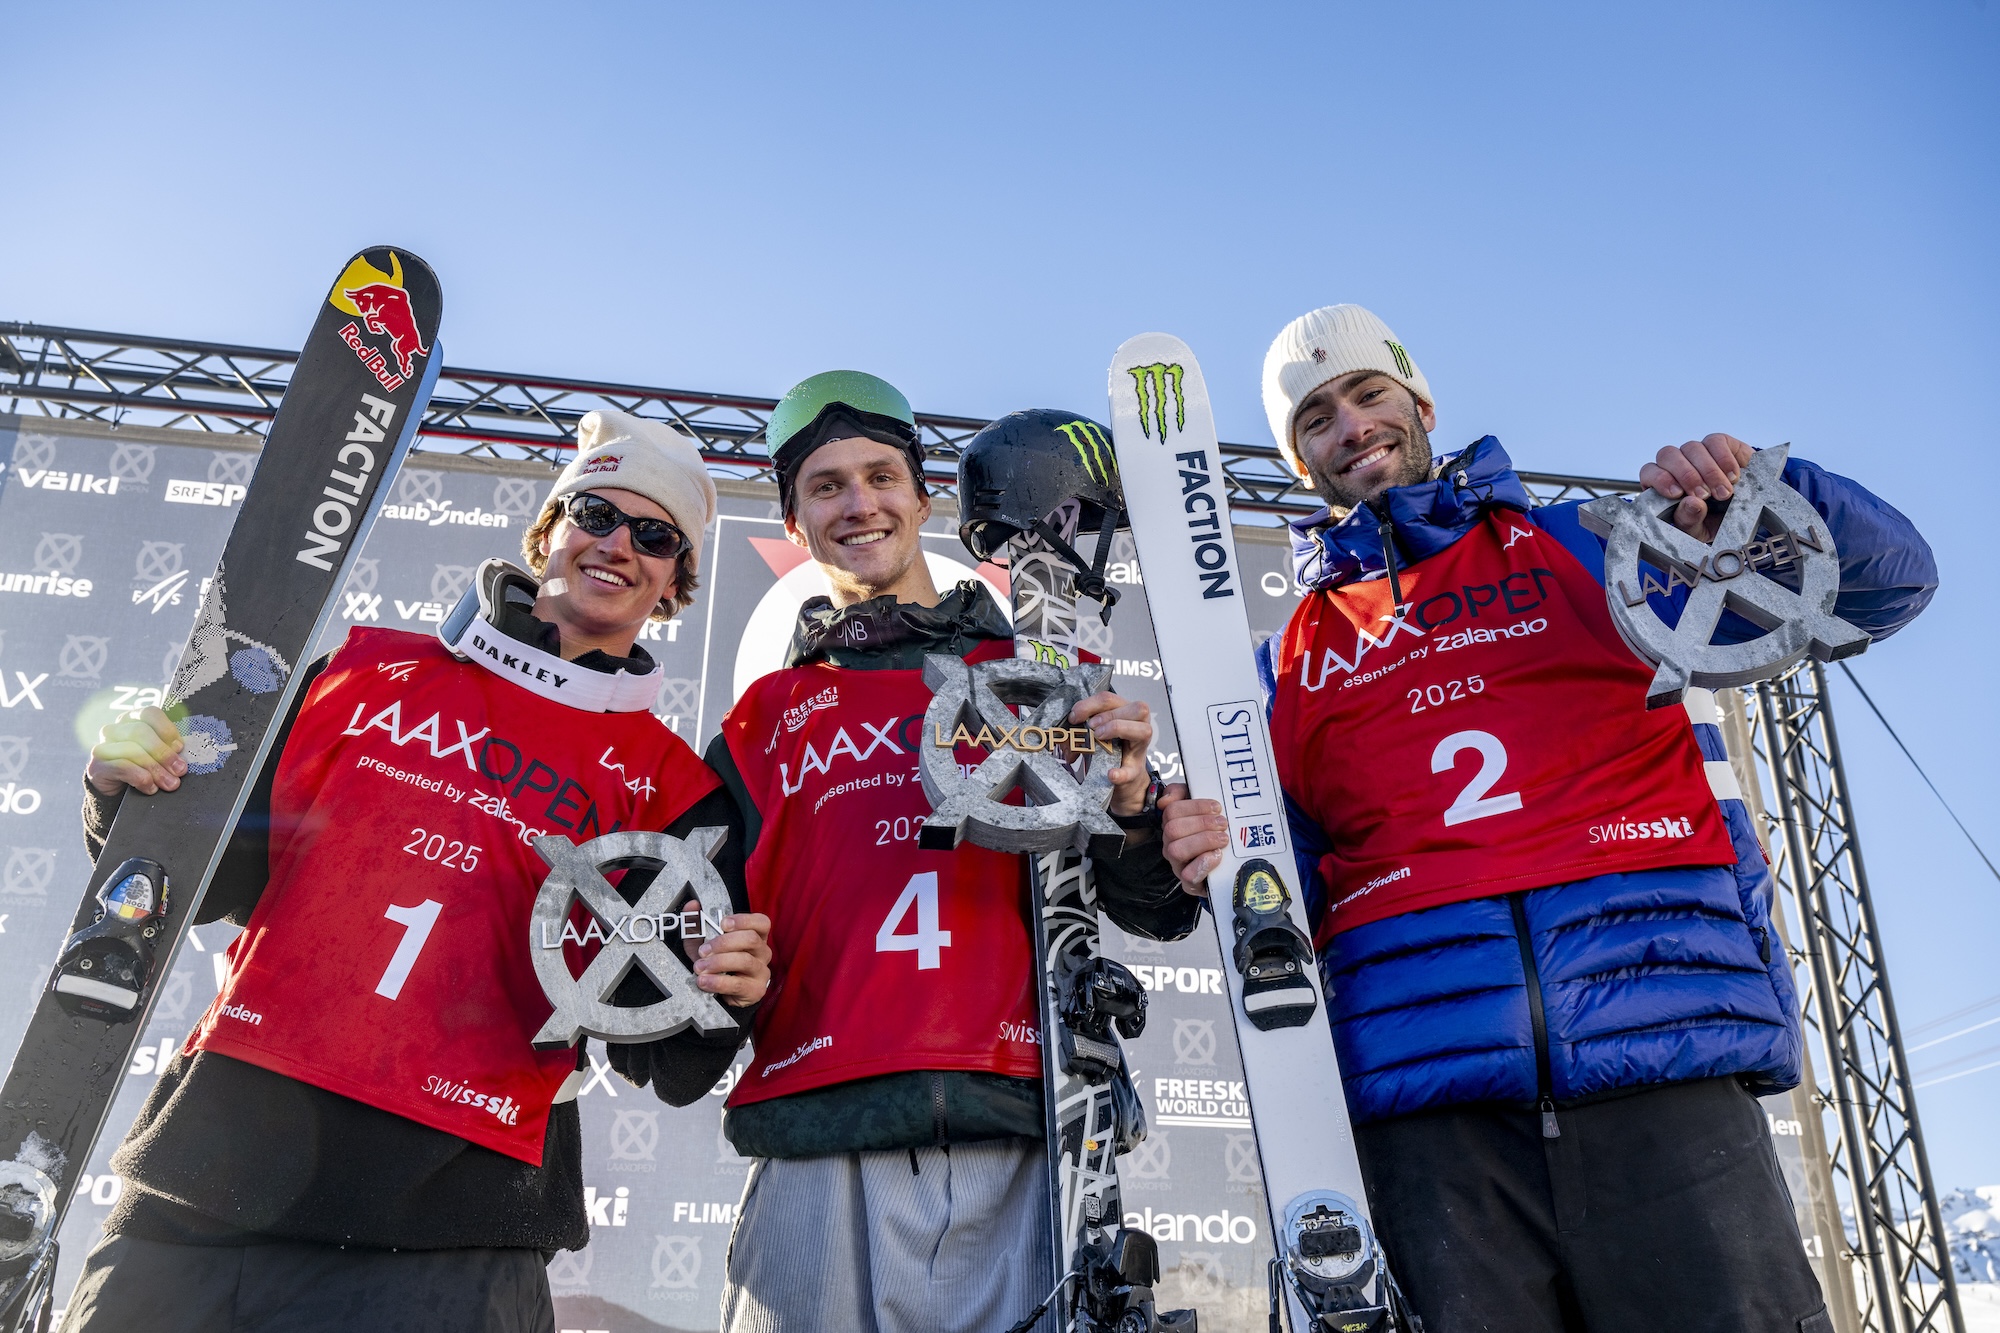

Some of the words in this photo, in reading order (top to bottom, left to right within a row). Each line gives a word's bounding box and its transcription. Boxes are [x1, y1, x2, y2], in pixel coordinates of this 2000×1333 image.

[337, 321, 378, 363] Red
[365, 346, 405, 393] Bull
[296, 392, 397, 573] FACTION
[599, 464, 619, 472] Bull
[171, 485, 202, 497] SRF
[1175, 449, 1235, 600] FACTION
[472, 634, 569, 689] OAKLEY
[1410, 646, 1430, 661] by
[1434, 617, 1548, 653] zalando
[1406, 674, 1486, 715] 2025
[356, 754, 445, 794] presented
[443, 782, 467, 804] by
[1216, 708, 1262, 810] STIFEL
[1431, 729, 1524, 827] 2
[814, 773, 882, 815] presented
[886, 772, 906, 787] by
[402, 827, 483, 873] 2025
[1262, 823, 1276, 846] US
[125, 898, 147, 909] LOOK
[875, 871, 952, 971] 4
[374, 898, 444, 1001] 1
[541, 908, 726, 950] LAAXOPEN
[1135, 965, 1225, 995] SPOR
[1156, 1098, 1219, 1116] WORLD
